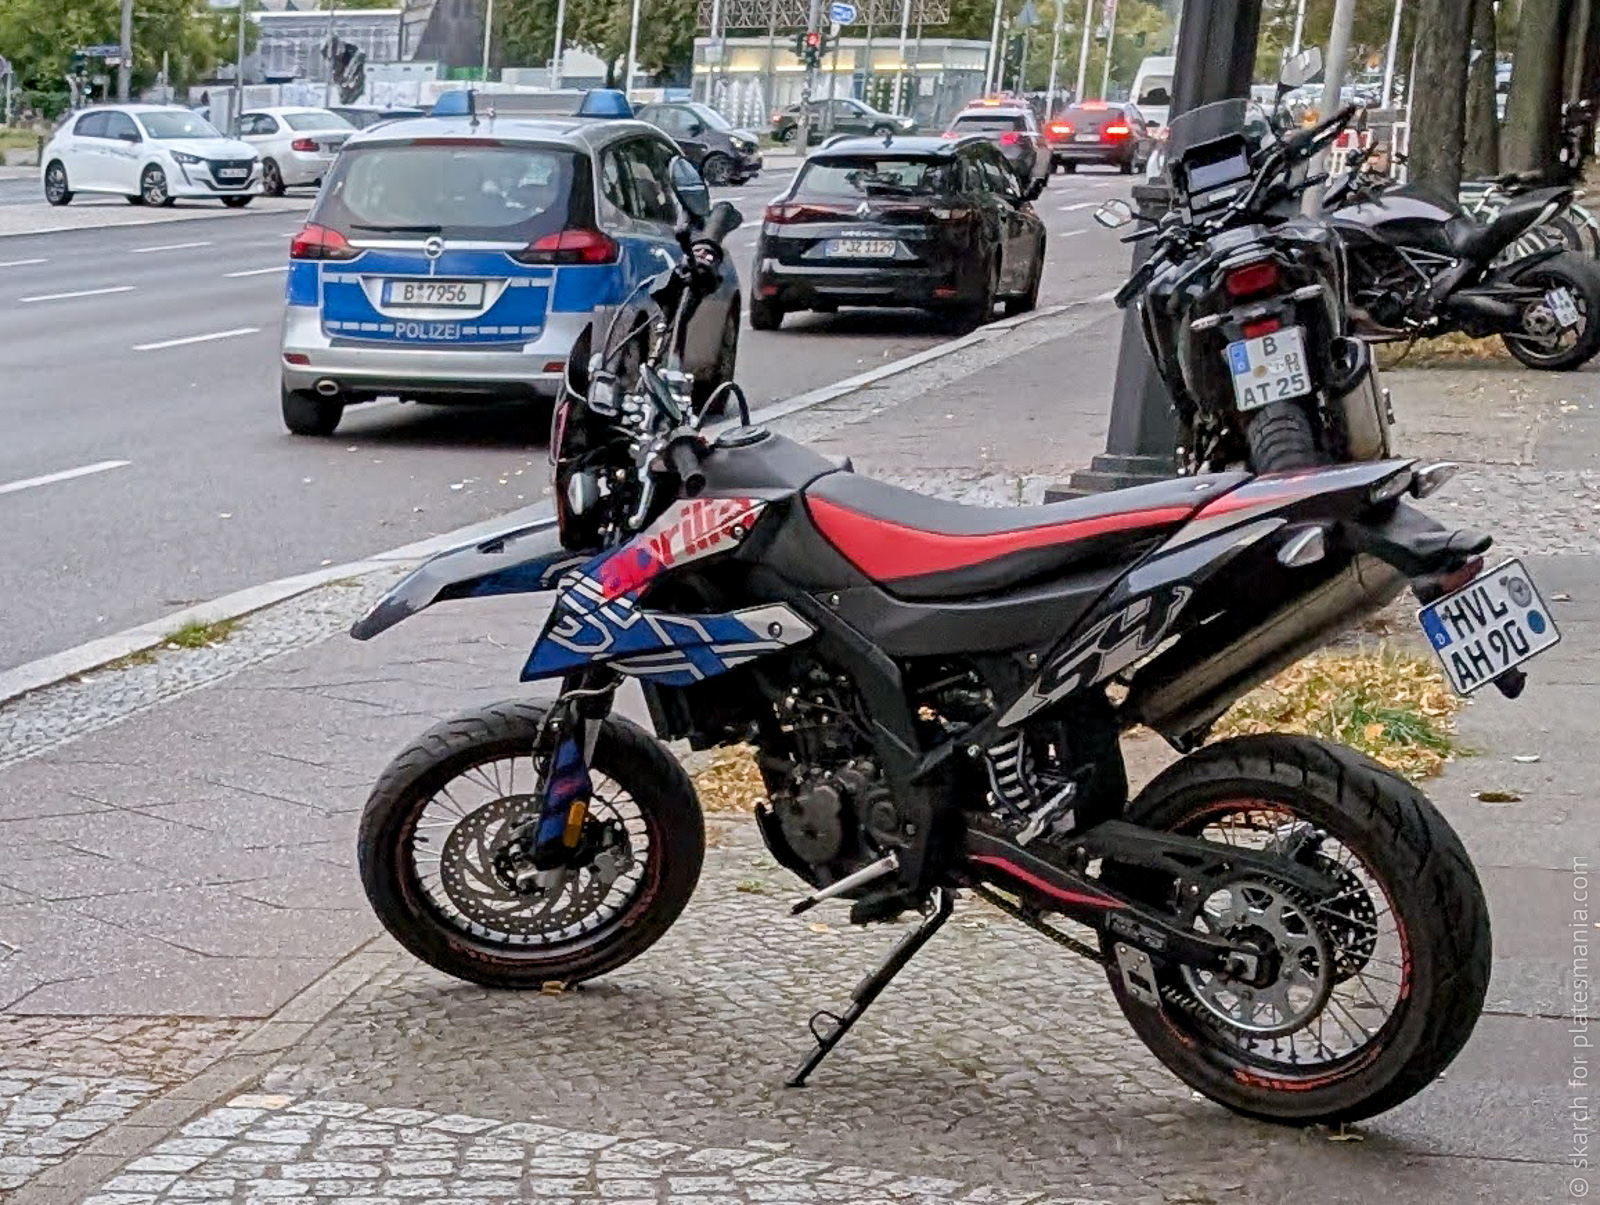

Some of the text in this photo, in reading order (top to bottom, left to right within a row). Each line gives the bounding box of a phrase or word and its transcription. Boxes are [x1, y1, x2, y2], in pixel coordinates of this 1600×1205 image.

[403, 284, 467, 302] B 7956
[395, 322, 461, 340] POLIZEI
[1262, 336, 1278, 357] B
[1243, 373, 1305, 407] AT 25
[1445, 585, 1509, 640] HVL
[1450, 619, 1531, 690] AH 90
